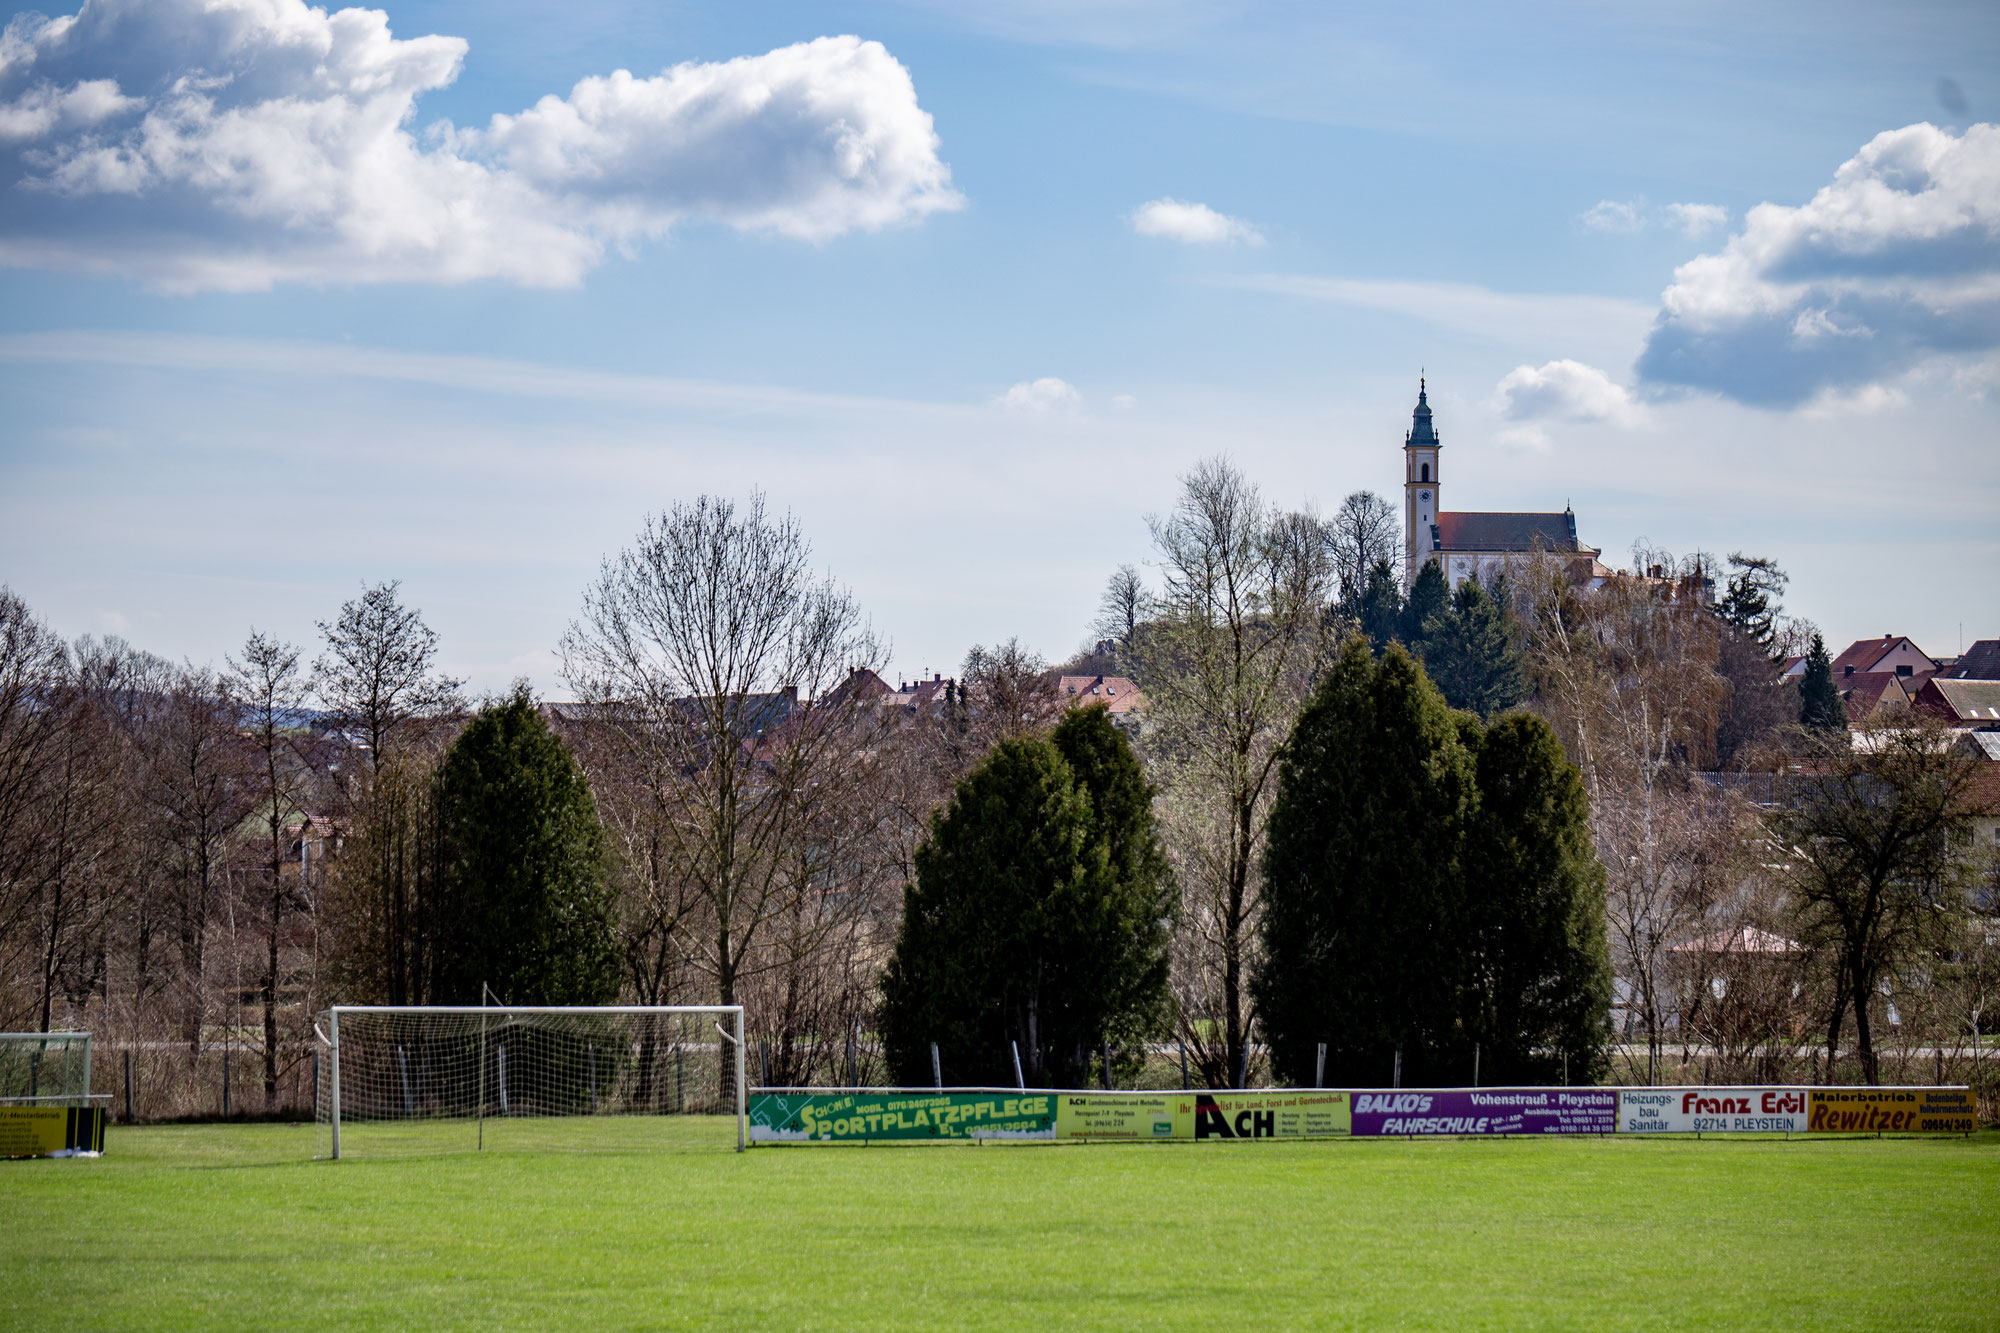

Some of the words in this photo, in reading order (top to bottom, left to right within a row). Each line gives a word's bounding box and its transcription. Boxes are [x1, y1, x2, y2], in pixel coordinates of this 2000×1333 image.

[1470, 1093, 1548, 1105] Vohenstrauß
[1558, 1093, 1614, 1107] Pleystein
[1623, 1093, 1675, 1106] Heizungs-
[1682, 1092, 1751, 1114] Franz
[1761, 1092, 1805, 1114] Ertl
[1812, 1092, 1916, 1102] Malerbetrieb
[1926, 1093, 1967, 1104] Bodenbeläge
[856, 1103, 884, 1114] MOBIL
[1180, 1103, 1191, 1113] Ihr
[1235, 1101, 1244, 1109] für
[1266, 1098, 1282, 1107] Forst
[1284, 1097, 1297, 1106] und
[1299, 1094, 1343, 1105] Gartentechnik
[1354, 1094, 1433, 1113] BALKO's
[1919, 1104, 1974, 1114] Vollwärmeschutz
[801, 1096, 1049, 1138] SPORTPLATZPFLEGE
[1195, 1095, 1275, 1138] ACH
[1524, 1108, 1560, 1116] Ausbildung
[1639, 1106, 1659, 1117] bau
[1810, 1103, 1917, 1130] Rewitzer
[1381, 1117, 1489, 1133] FAHRSCHULE
[1493, 1122, 1523, 1132] Seminare
[1629, 1118, 1669, 1130] Sanitär
[1693, 1118, 1727, 1130] 92714
[1734, 1118, 1794, 1130] PLEYSTEIN
[1921, 1118, 1973, 1130] 09654/349
